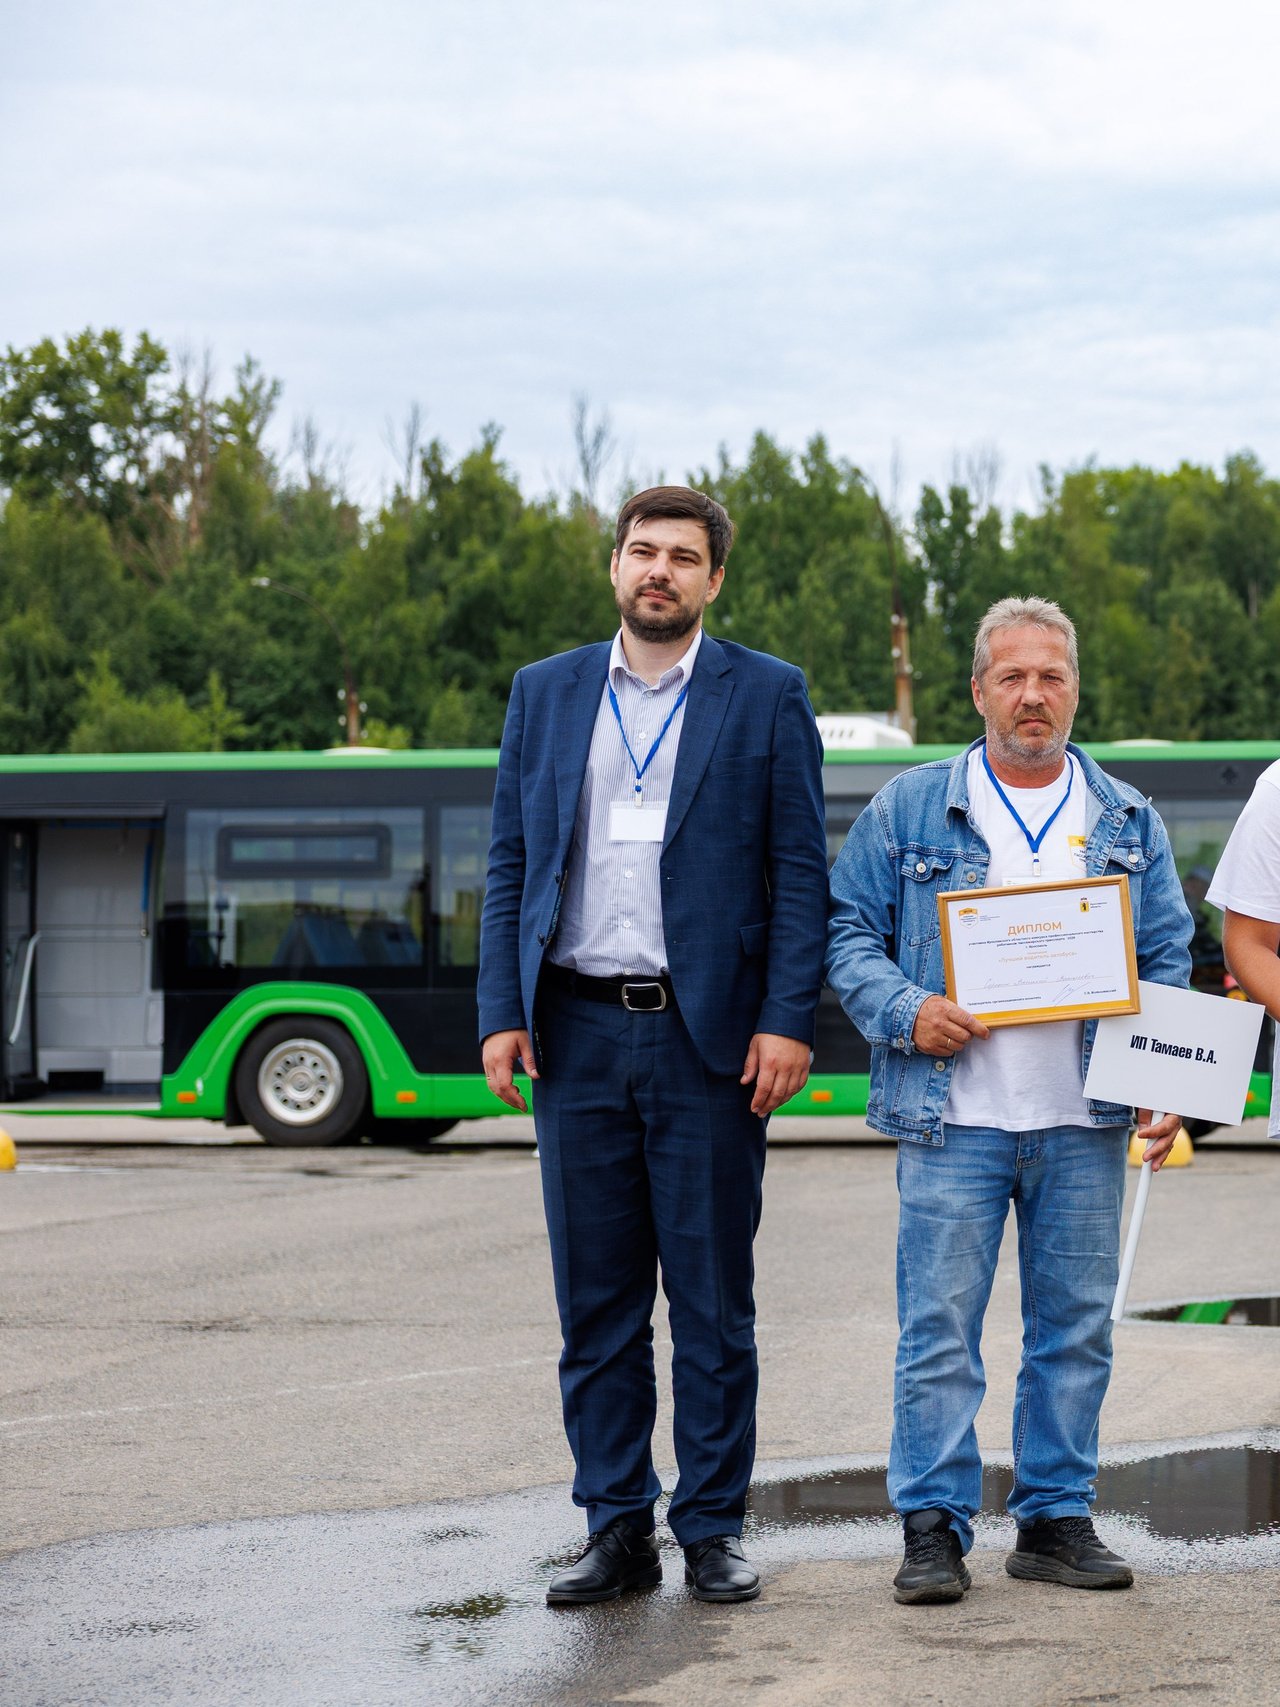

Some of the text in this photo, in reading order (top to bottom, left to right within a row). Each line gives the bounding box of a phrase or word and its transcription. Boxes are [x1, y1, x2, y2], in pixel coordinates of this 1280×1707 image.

[1007, 921, 1062, 936] ДИПЛОМ
[1130, 1034, 1217, 1064] ИП Тамаев В.А.
